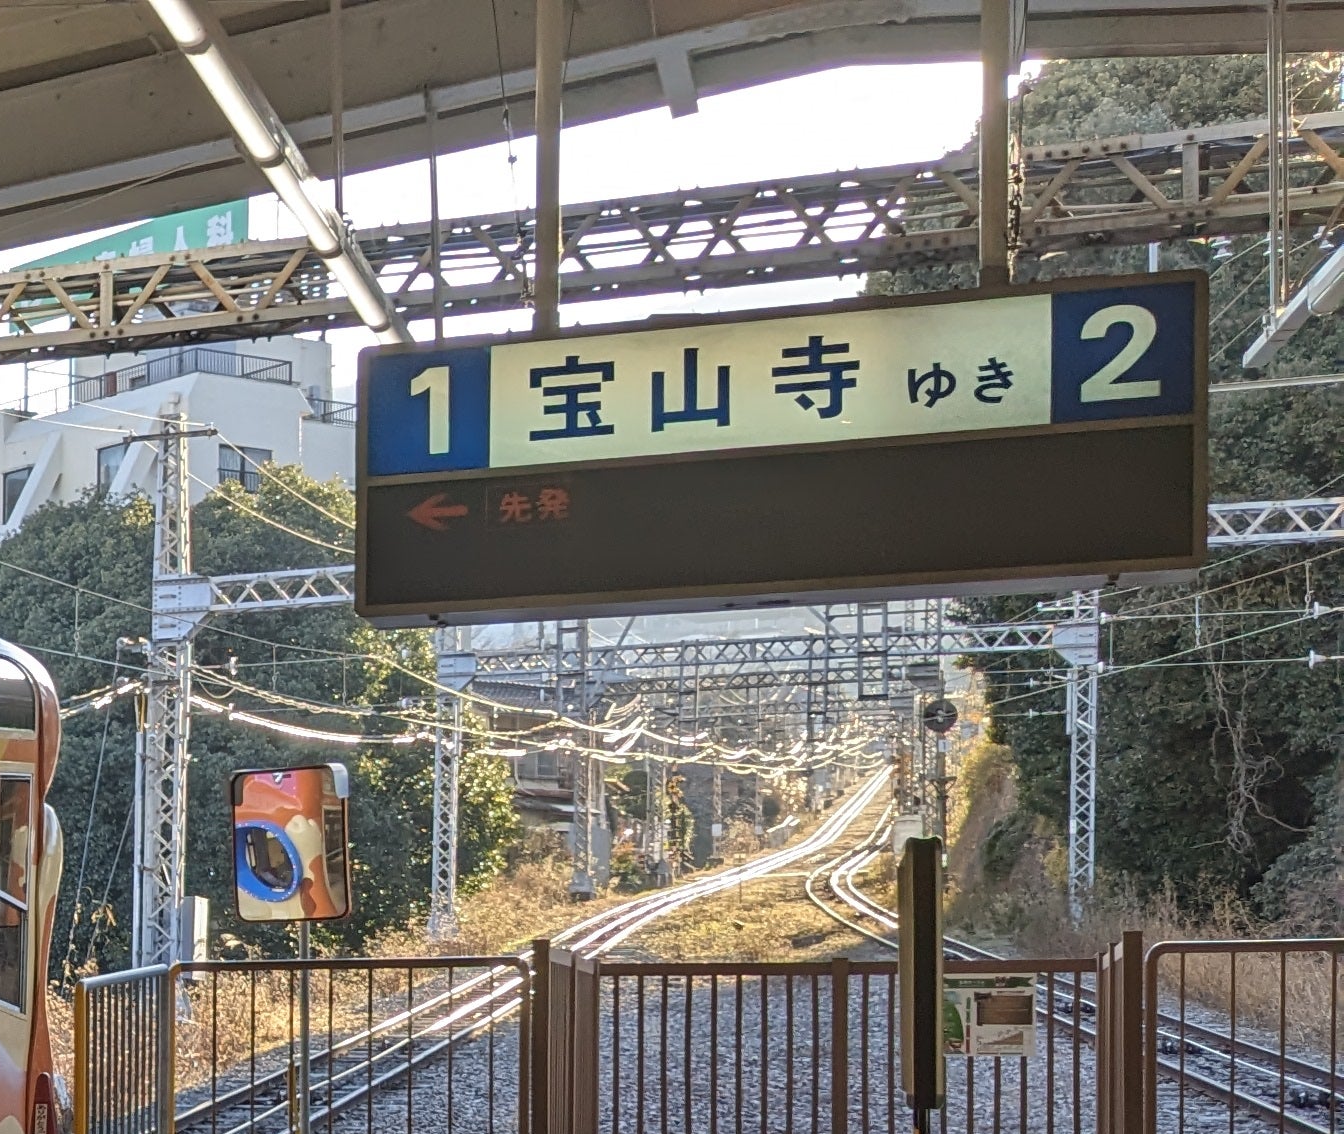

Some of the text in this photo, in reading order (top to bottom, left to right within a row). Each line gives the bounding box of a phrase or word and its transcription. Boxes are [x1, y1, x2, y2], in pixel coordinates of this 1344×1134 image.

[529, 335, 1014, 441] 宝山寺 ゆき
[1080, 304, 1161, 403] 2
[410, 366, 450, 455] 1
[500, 488, 569, 522] 先発
